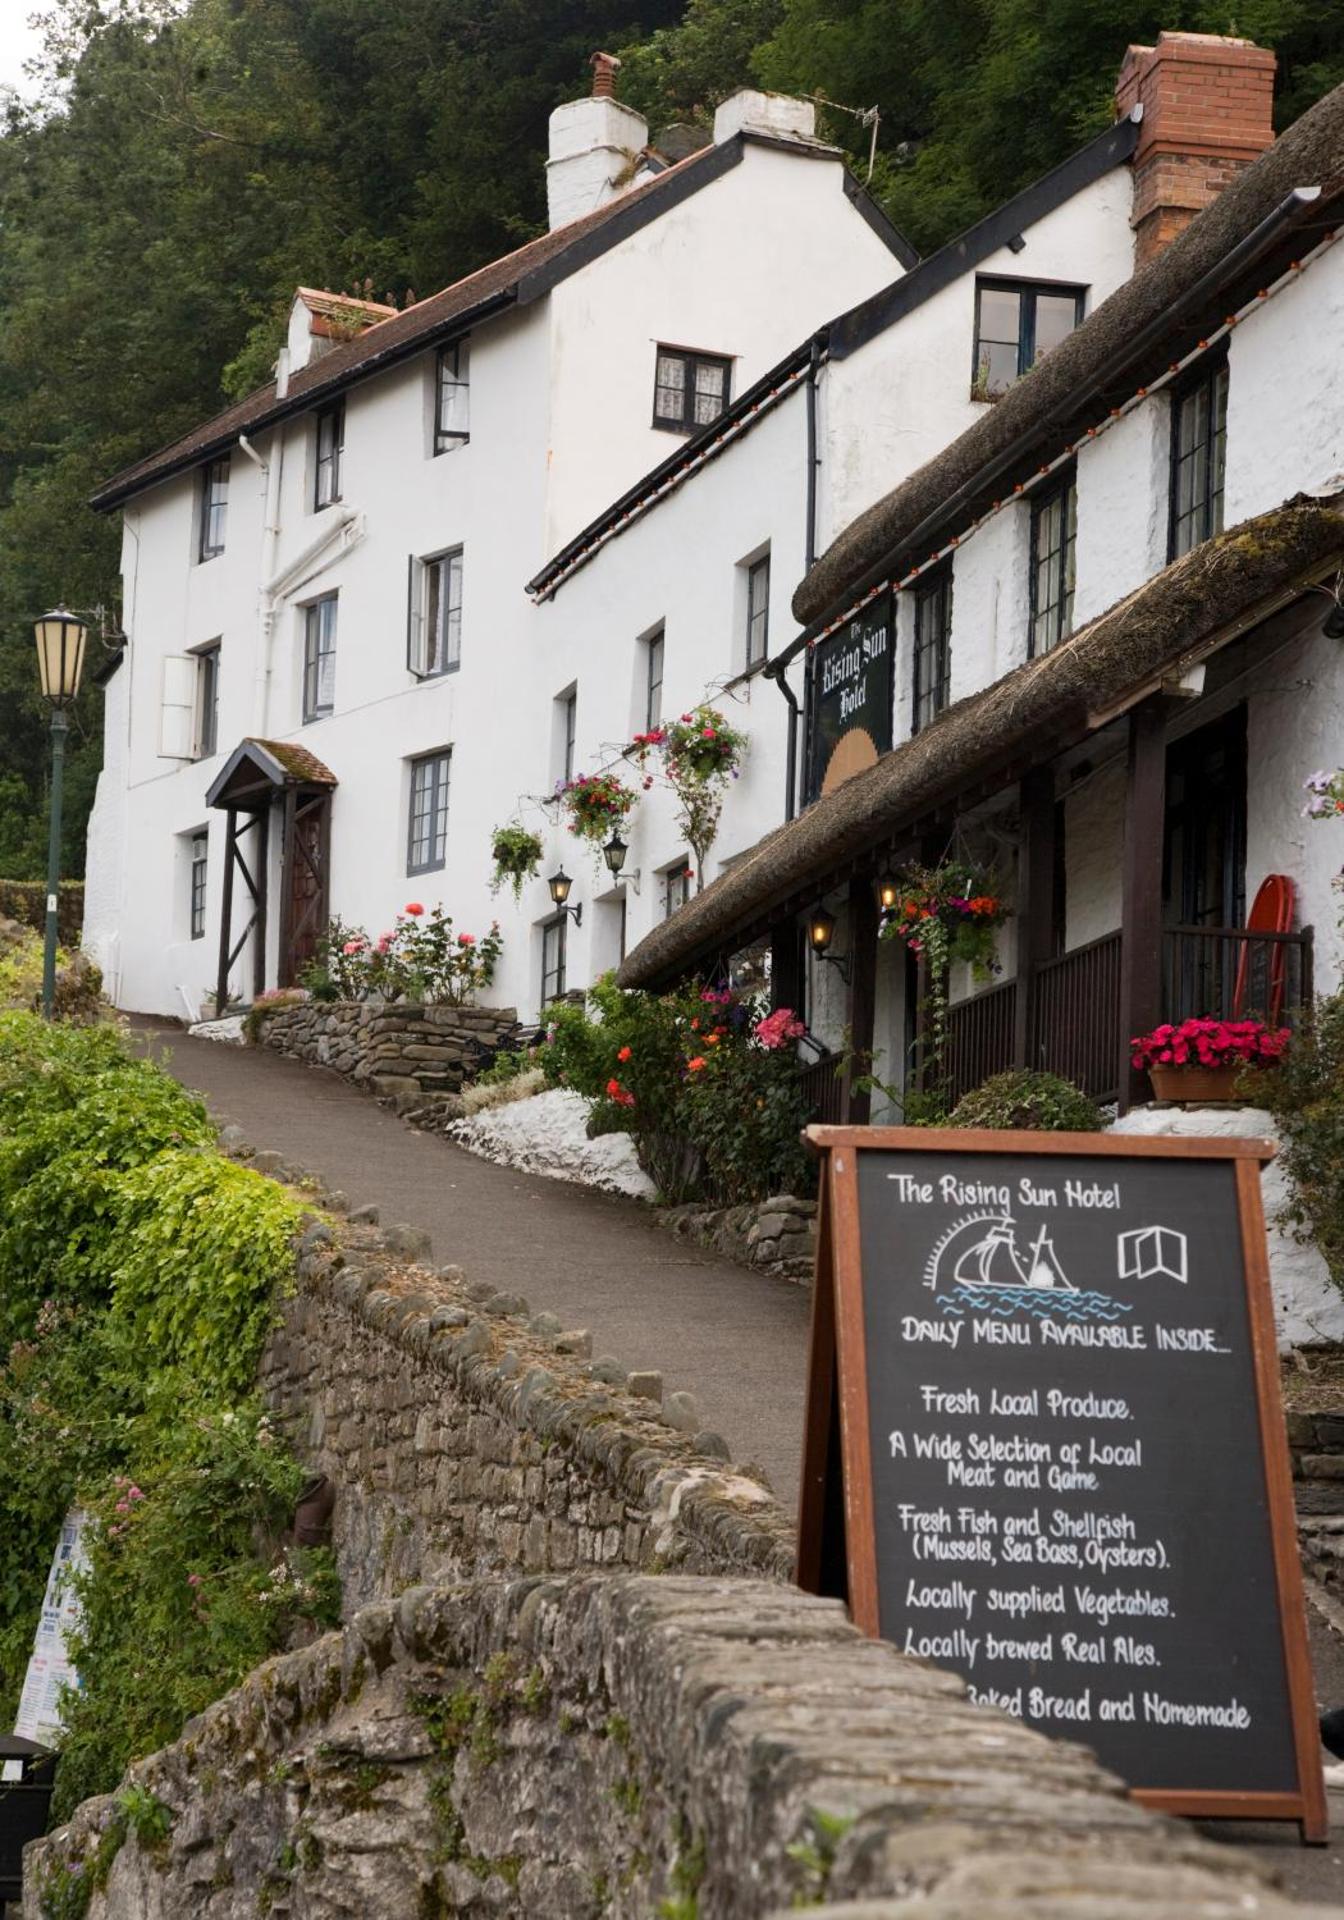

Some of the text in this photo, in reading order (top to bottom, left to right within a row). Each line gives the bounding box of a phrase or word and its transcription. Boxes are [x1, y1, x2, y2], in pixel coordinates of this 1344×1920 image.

[823, 626, 886, 695] Rising Sun
[839, 674, 867, 725] Hotel
[887, 1173, 1121, 1217] The Rising Sun Hotel
[901, 1316, 965, 1350] DAILY
[973, 1317, 1031, 1345] MENU
[1039, 1318, 1148, 1350] AVAILABLE
[920, 1385, 1135, 1420] Fresh Local Produce.
[889, 1430, 1142, 1474] A Wide Selection of Local
[947, 1461, 1099, 1493] Meat and Game
[898, 1503, 1136, 1544] Fresh Fish and Shellfish
[912, 1533, 998, 1567] (Mussels,
[1001, 1536, 1034, 1563] Sea
[1035, 1536, 1084, 1570] Bass,
[906, 1579, 1176, 1627] Locally supplied Vegetables.
[904, 1627, 1161, 1669] Locally brewed Real Ales.
[1029, 1686, 1091, 1721] Bread
[1098, 1692, 1136, 1722] and
[1143, 1692, 1250, 1729] Homemade
